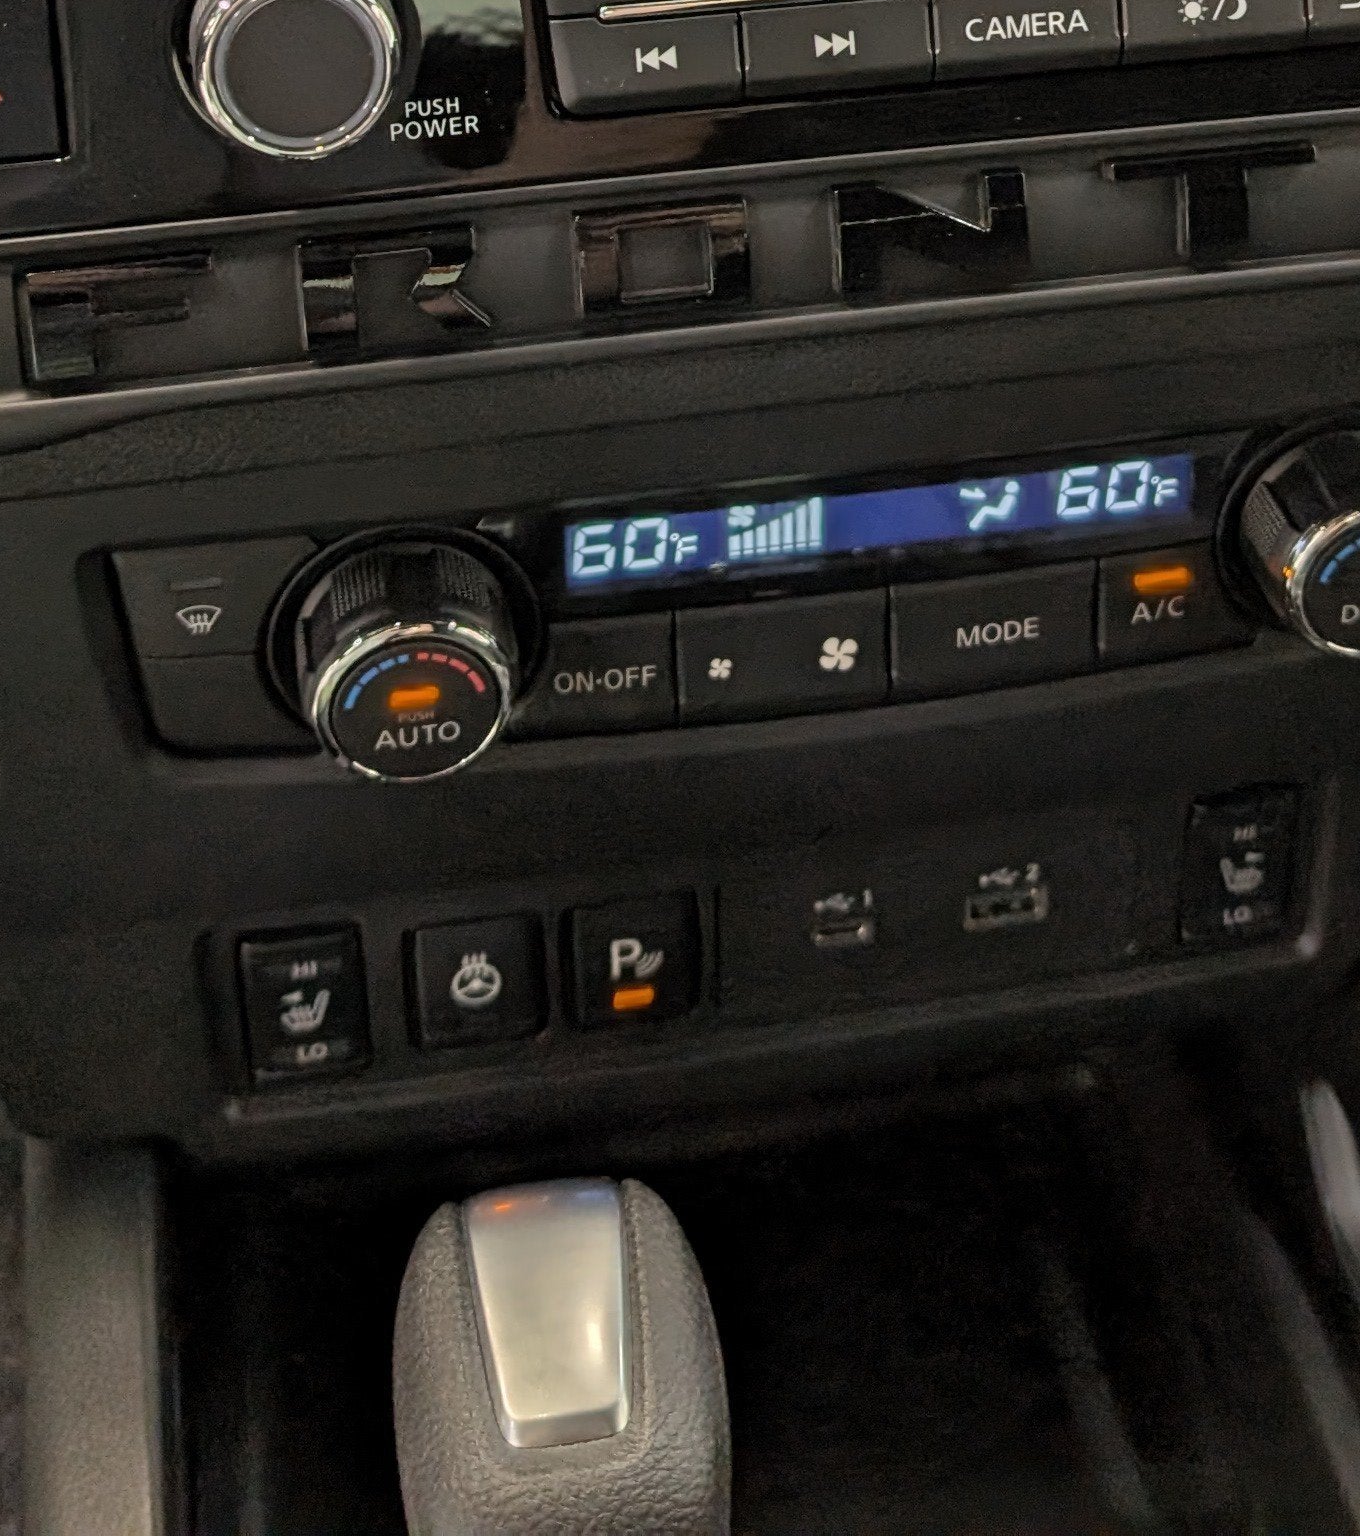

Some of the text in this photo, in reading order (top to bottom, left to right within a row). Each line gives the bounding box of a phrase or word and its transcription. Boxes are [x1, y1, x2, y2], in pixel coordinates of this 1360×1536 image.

[965, 10, 1089, 43] CAMERA
[404, 96, 461, 118] PUSH
[389, 115, 480, 140] POWER
[1130, 595, 1186, 625] A/C
[955, 616, 1040, 649] MODE
[374, 721, 460, 750] AUTO
